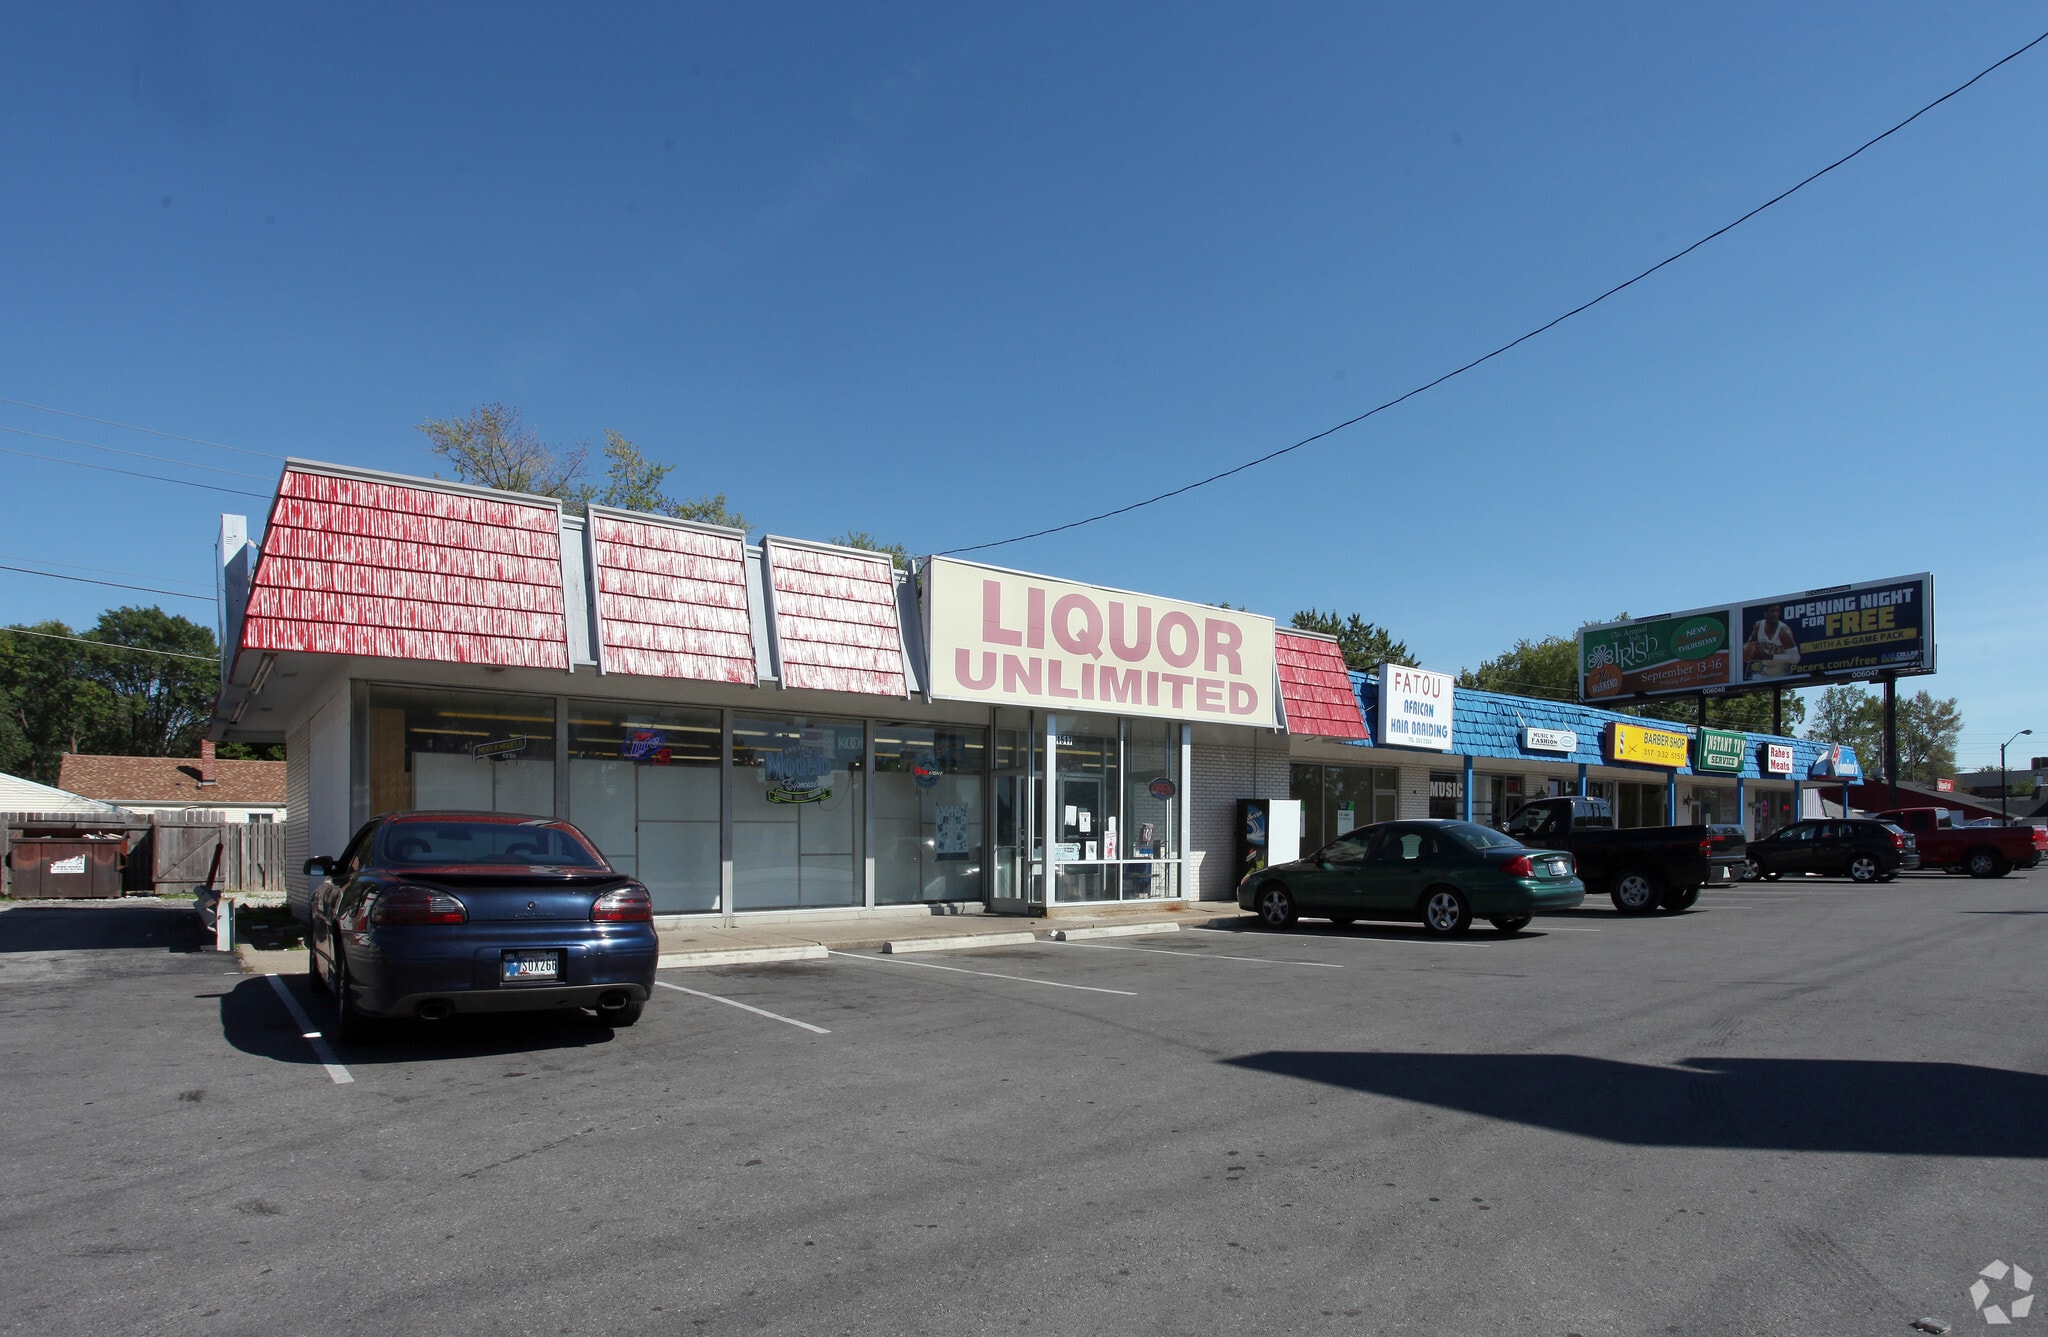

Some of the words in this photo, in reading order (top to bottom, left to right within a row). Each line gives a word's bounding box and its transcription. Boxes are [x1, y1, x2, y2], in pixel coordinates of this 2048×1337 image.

[1784, 597, 1856, 620] OPENING
[1861, 588, 1914, 609] NIGHT
[982, 580, 1243, 676] LIQUOR
[1802, 615, 1825, 628] FOR
[1825, 606, 1895, 637] FREE
[1624, 625, 1648, 637] Annual
[1686, 625, 1707, 637] NEW
[1678, 636, 1718, 654] THURSDAY
[1812, 641, 1834, 650] WITH
[1844, 635, 1877, 647] 6-GAME
[1880, 632, 1904, 642] PACK
[1790, 656, 1877, 673] Pacers.com/free
[955, 648, 1259, 715] UNLIMITED
[1641, 665, 1693, 683] September
[1851, 670, 1879, 678] 006047
[1394, 671, 1441, 699] FATOU
[1591, 678, 1619, 693] WEEKEND
[1404, 699, 1434, 718] AFRICAN
[1391, 718, 1409, 735] HAIR
[1412, 720, 1448, 739] BRAIDING
[1531, 737, 1558, 745] FASHION
[1643, 732, 1669, 747] BARBER
[1669, 735, 1686, 749] SHOP
[1703, 734, 1733, 757] INSTANT
[1733, 738, 1746, 761] TAX
[1643, 748, 1654, 757] 317
[1657, 750, 1669, 759] 332
[1671, 752, 1685, 760] 5150
[1710, 756, 1736, 766] SERVICE
[1770, 747, 1790, 759] Rahe's
[765, 751, 831, 780] Modelo
[1770, 760, 1790, 772] Meats
[782, 777, 818, 791] Especial
[1429, 781, 1463, 798] MUSIC
